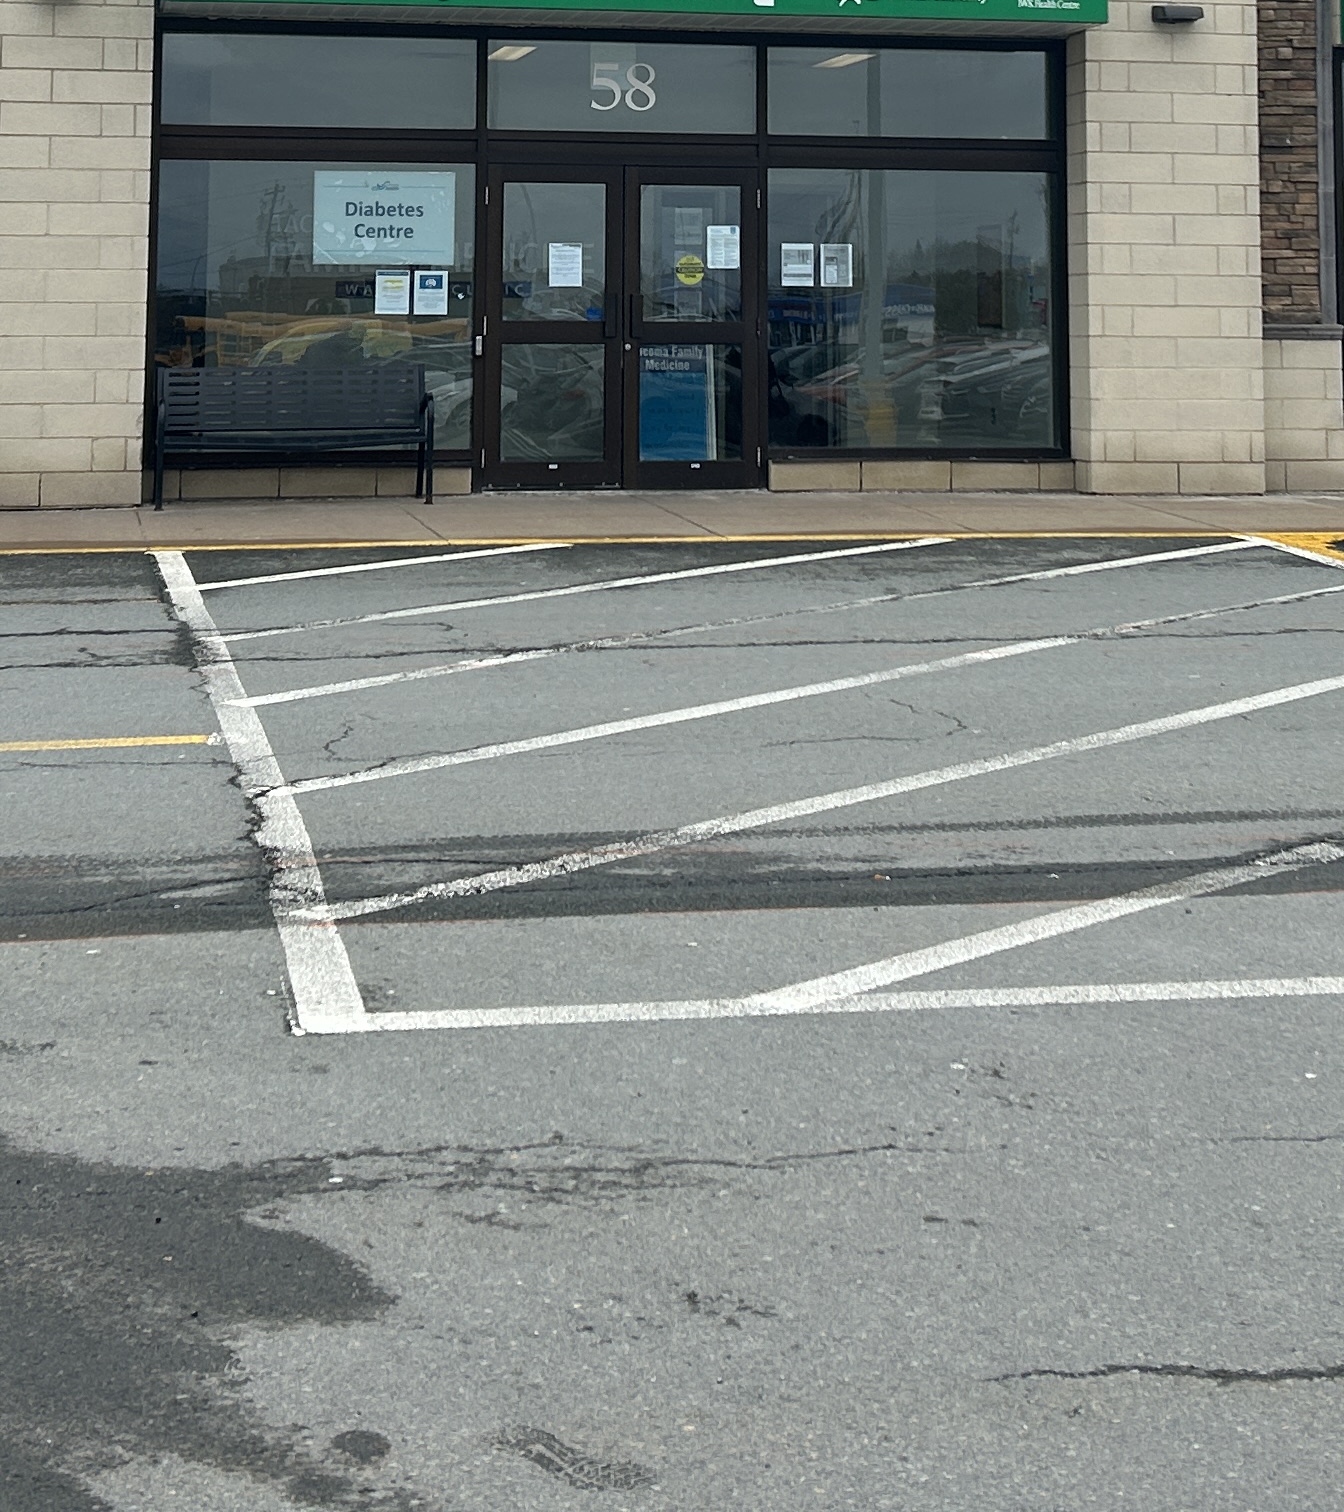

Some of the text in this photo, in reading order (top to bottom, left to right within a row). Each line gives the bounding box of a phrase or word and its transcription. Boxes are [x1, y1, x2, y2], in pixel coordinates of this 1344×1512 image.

[590, 62, 656, 112] 58
[345, 200, 424, 218] Diabetes
[354, 223, 414, 239] Centre
[671, 345, 703, 359] Family
[645, 359, 690, 371] Medicine
